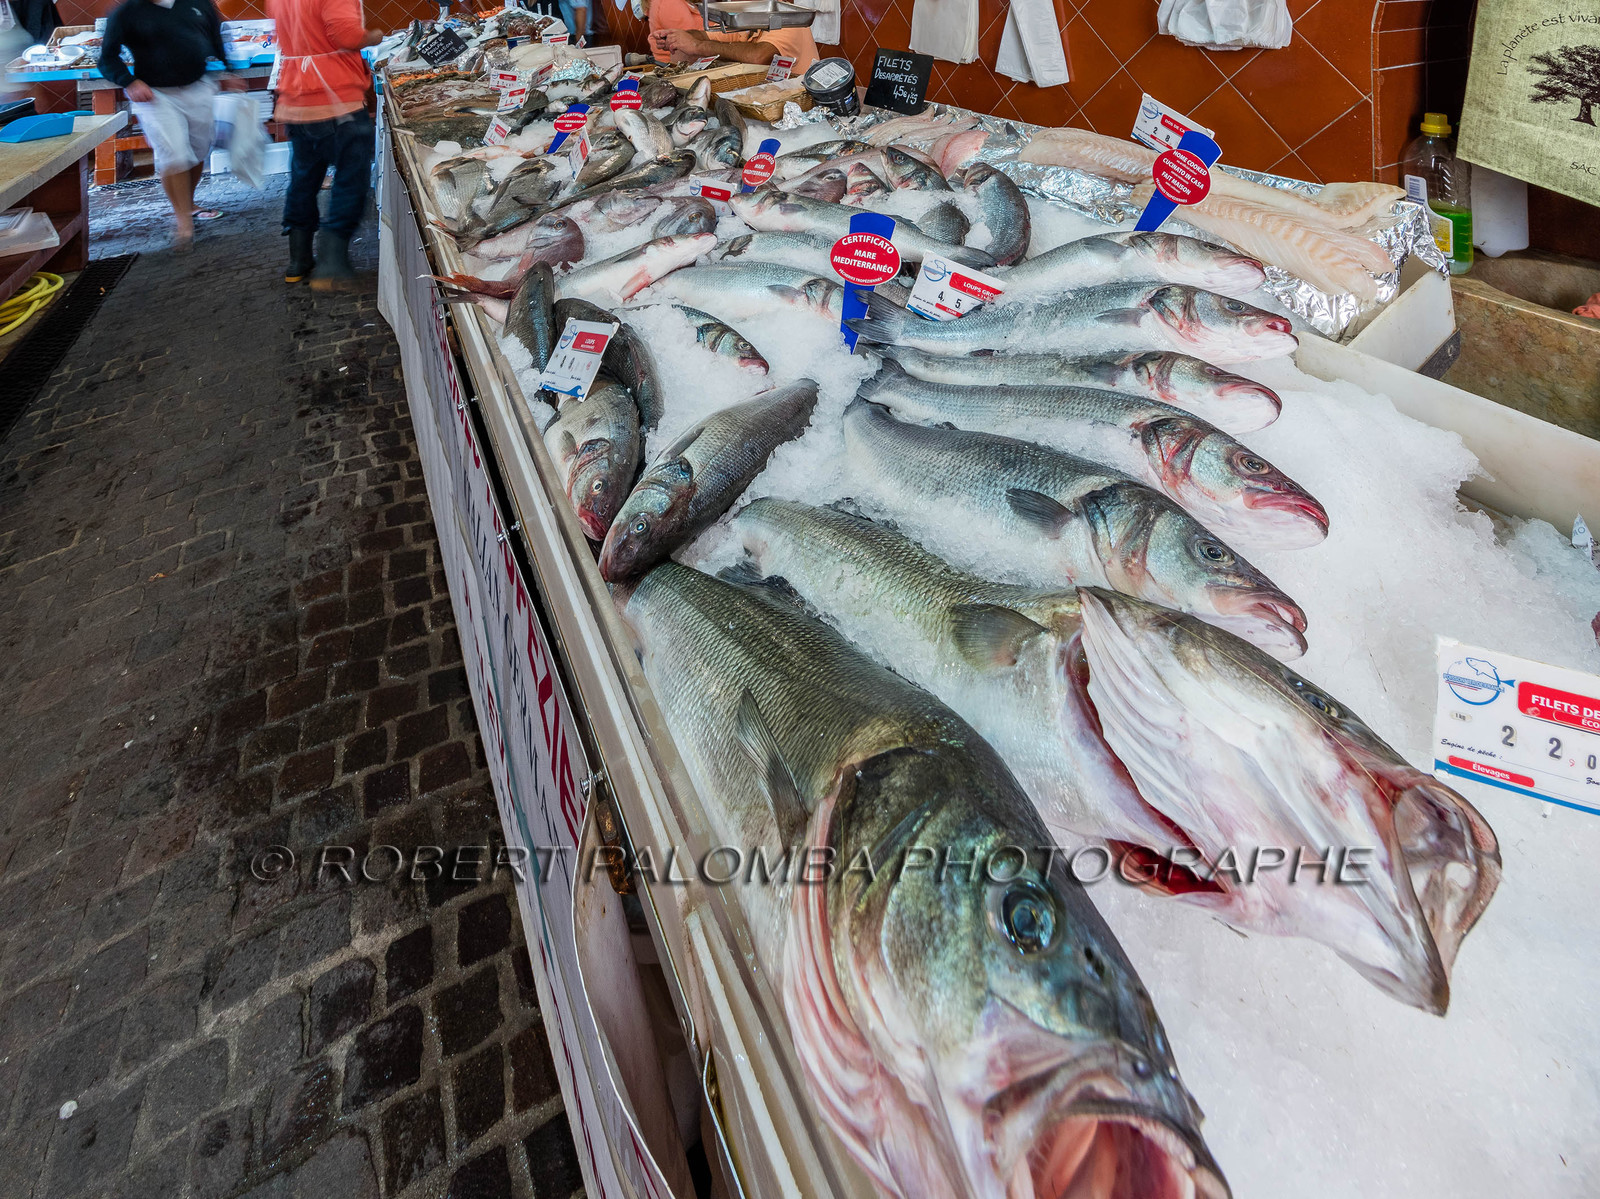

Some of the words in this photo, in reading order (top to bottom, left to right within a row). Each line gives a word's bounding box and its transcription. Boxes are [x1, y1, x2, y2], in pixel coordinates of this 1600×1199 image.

[1542, 13, 1565, 28] est
[1502, 22, 1540, 62] planète
[877, 55, 913, 72] FILETS
[1497, 60, 1509, 75] La
[1153, 126, 1159, 135] 2
[1172, 150, 1188, 163] HOME
[1187, 159, 1208, 176] COOKED
[1570, 161, 1598, 176] SAC
[1162, 157, 1186, 176] CUCINATO
[1185, 172, 1192, 180] IN
[1190, 176, 1205, 190] CASA
[1161, 171, 1173, 181] FAIT
[1171, 178, 1191, 196] MAISON
[841, 234, 895, 255] CERTIFICATO
[854, 249, 877, 260] MARE
[833, 255, 894, 274] MEDITERRANÉO
[963, 281, 982, 293] LOUPS
[1531, 694, 1581, 717] FILETS
[1583, 706, 1600, 719] DE
[1501, 725, 1515, 747] 2
[1466, 745, 1476, 753] de
[1472, 762, 1511, 781] Élevages
